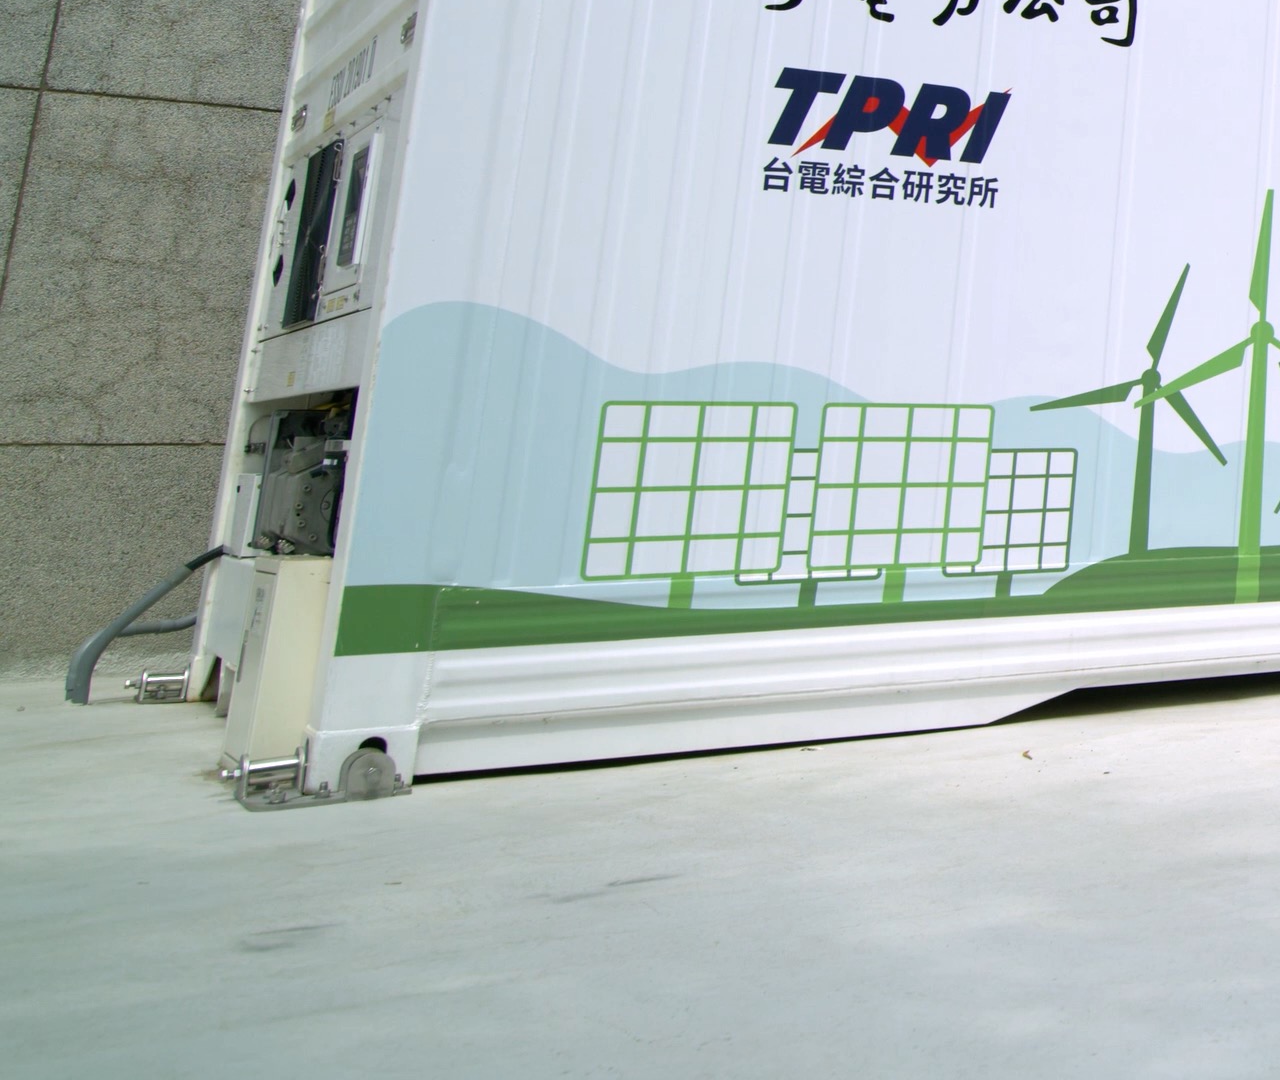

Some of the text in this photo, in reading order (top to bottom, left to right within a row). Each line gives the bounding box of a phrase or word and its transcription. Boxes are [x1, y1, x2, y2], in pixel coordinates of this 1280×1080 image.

[767, 66, 1013, 166] TPRI
[761, 156, 999, 209] 台電綜合研究所
